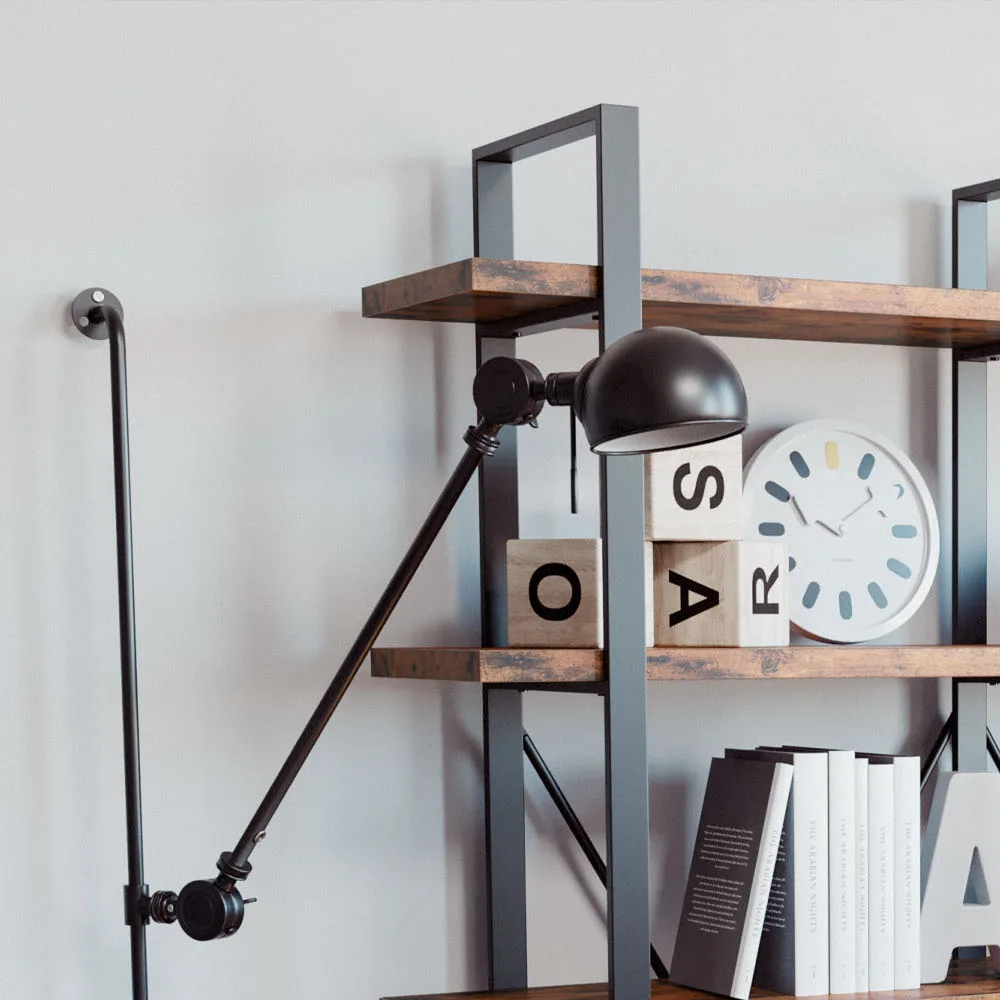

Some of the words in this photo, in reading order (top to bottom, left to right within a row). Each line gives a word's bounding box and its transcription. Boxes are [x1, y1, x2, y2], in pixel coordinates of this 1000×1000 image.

[672, 461, 725, 511] S
[528, 562, 582, 622] O
[668, 569, 720, 628] A
[751, 564, 780, 615] R
